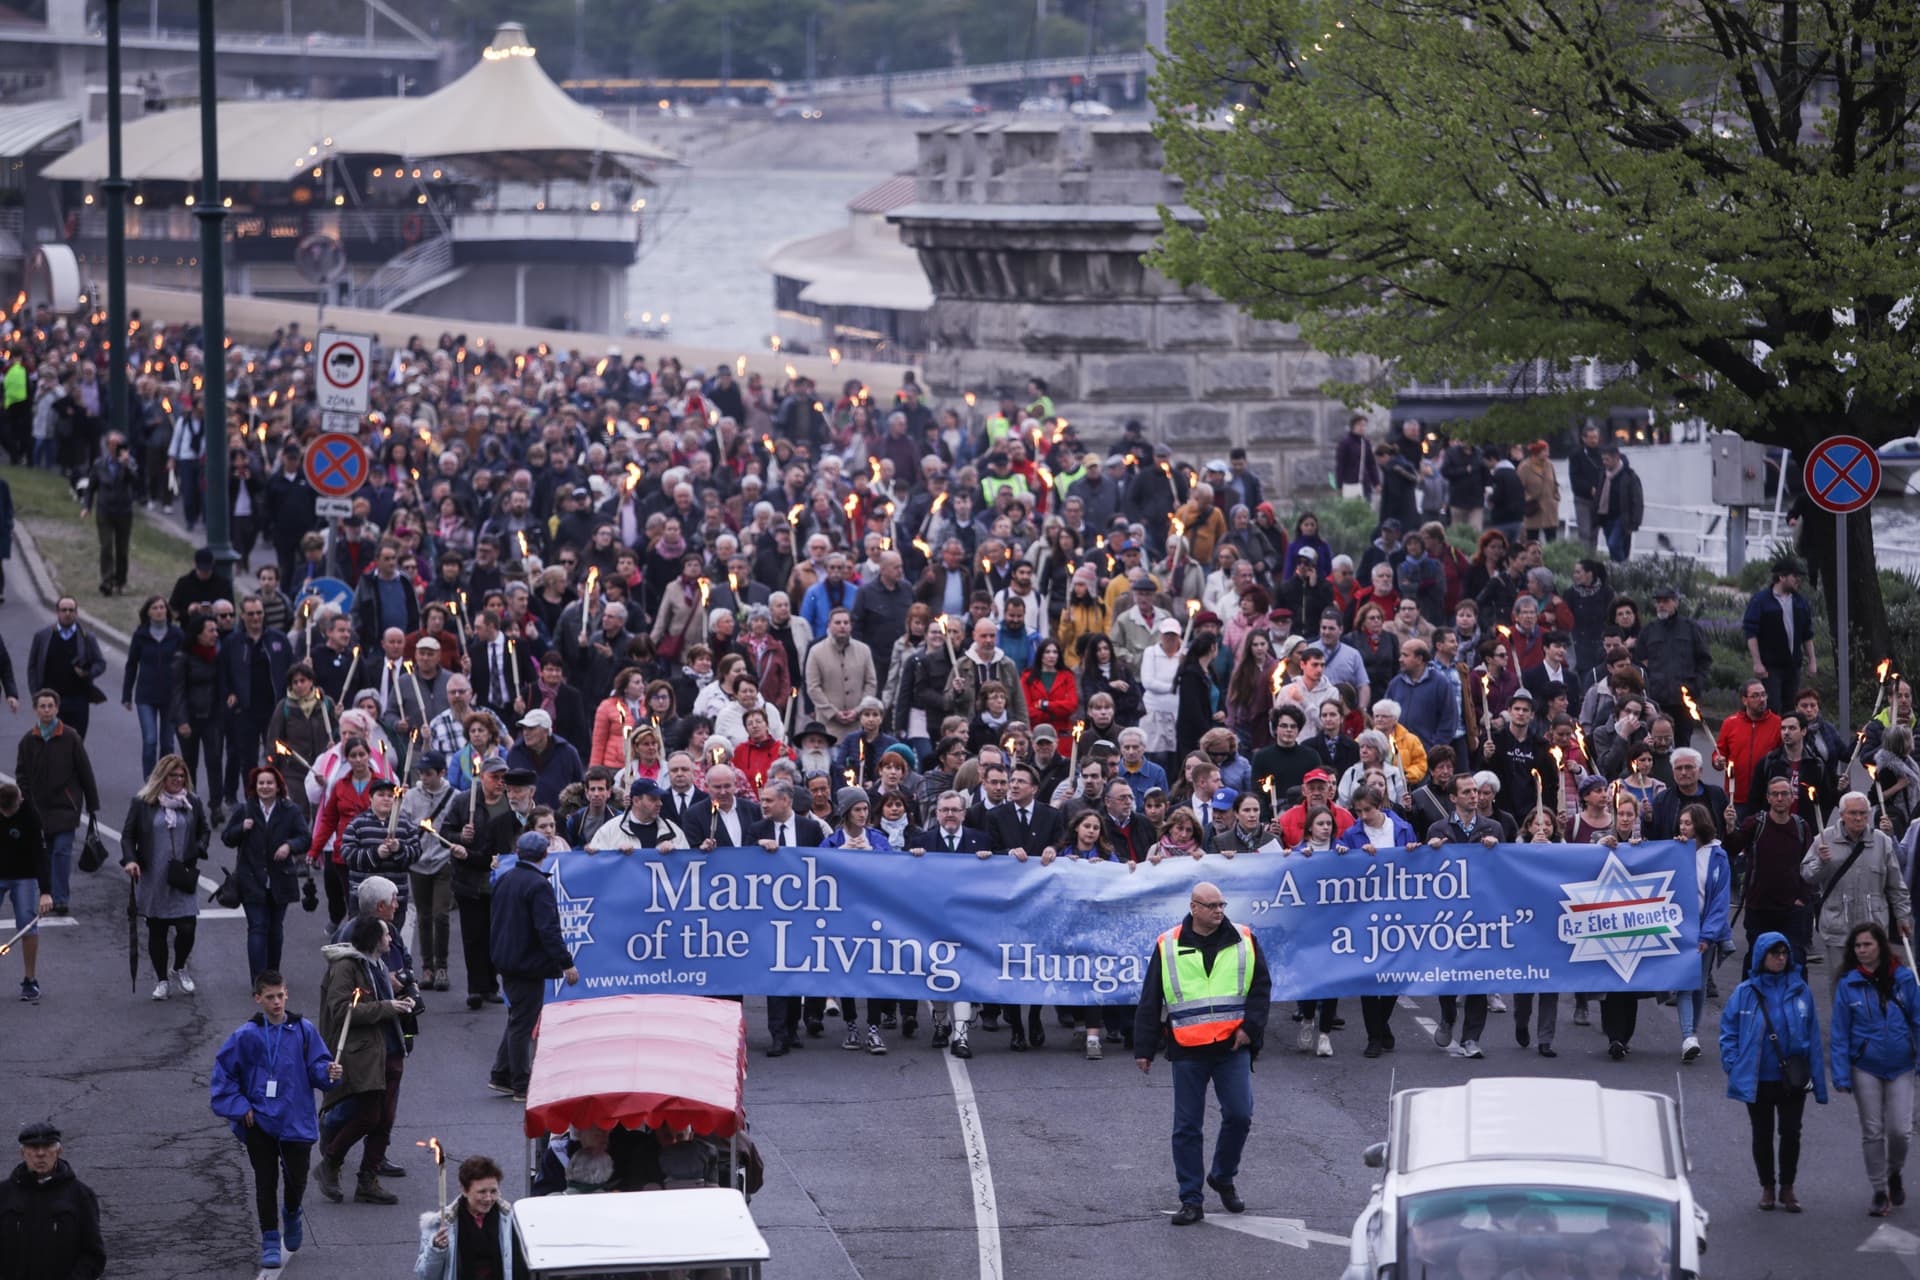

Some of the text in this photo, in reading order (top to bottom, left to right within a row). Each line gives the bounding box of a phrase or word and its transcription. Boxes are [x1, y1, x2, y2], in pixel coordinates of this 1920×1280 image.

[644, 857, 842, 913] March
[1317, 859, 1471, 905] múltról
[1331, 926, 1355, 954] a
[1563, 906, 1678, 936] Az Élet Menete
[626, 918, 961, 993] of the Living
[997, 944, 1152, 993] Hunga
[1376, 965, 1550, 984] www.eletmenete.hu
[585, 968, 707, 987] www.motl.org
